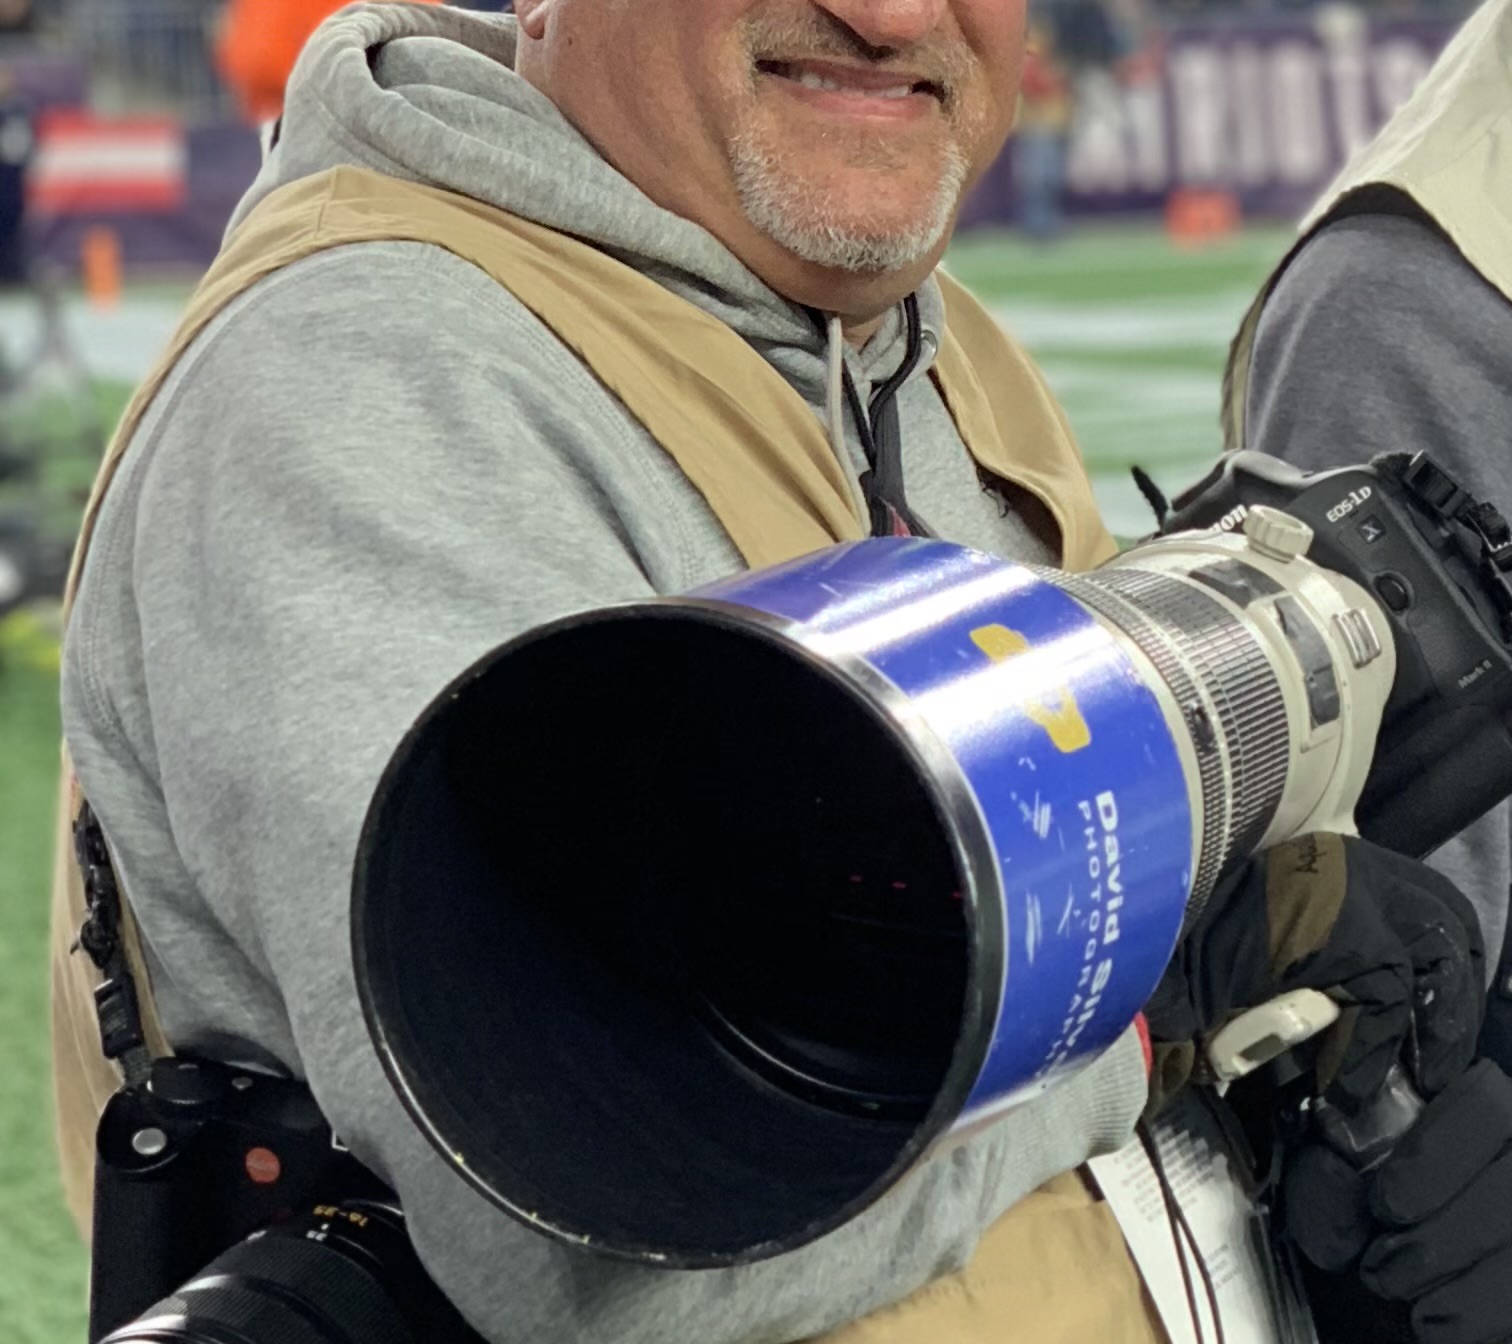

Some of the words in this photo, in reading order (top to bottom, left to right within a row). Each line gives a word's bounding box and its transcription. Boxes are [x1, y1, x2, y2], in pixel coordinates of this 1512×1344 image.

[1325, 485, 1372, 523] EOS-1D
[1360, 519, 1382, 542] X
[1457, 666, 1486, 689] Mark
[1095, 790, 1124, 946] David
